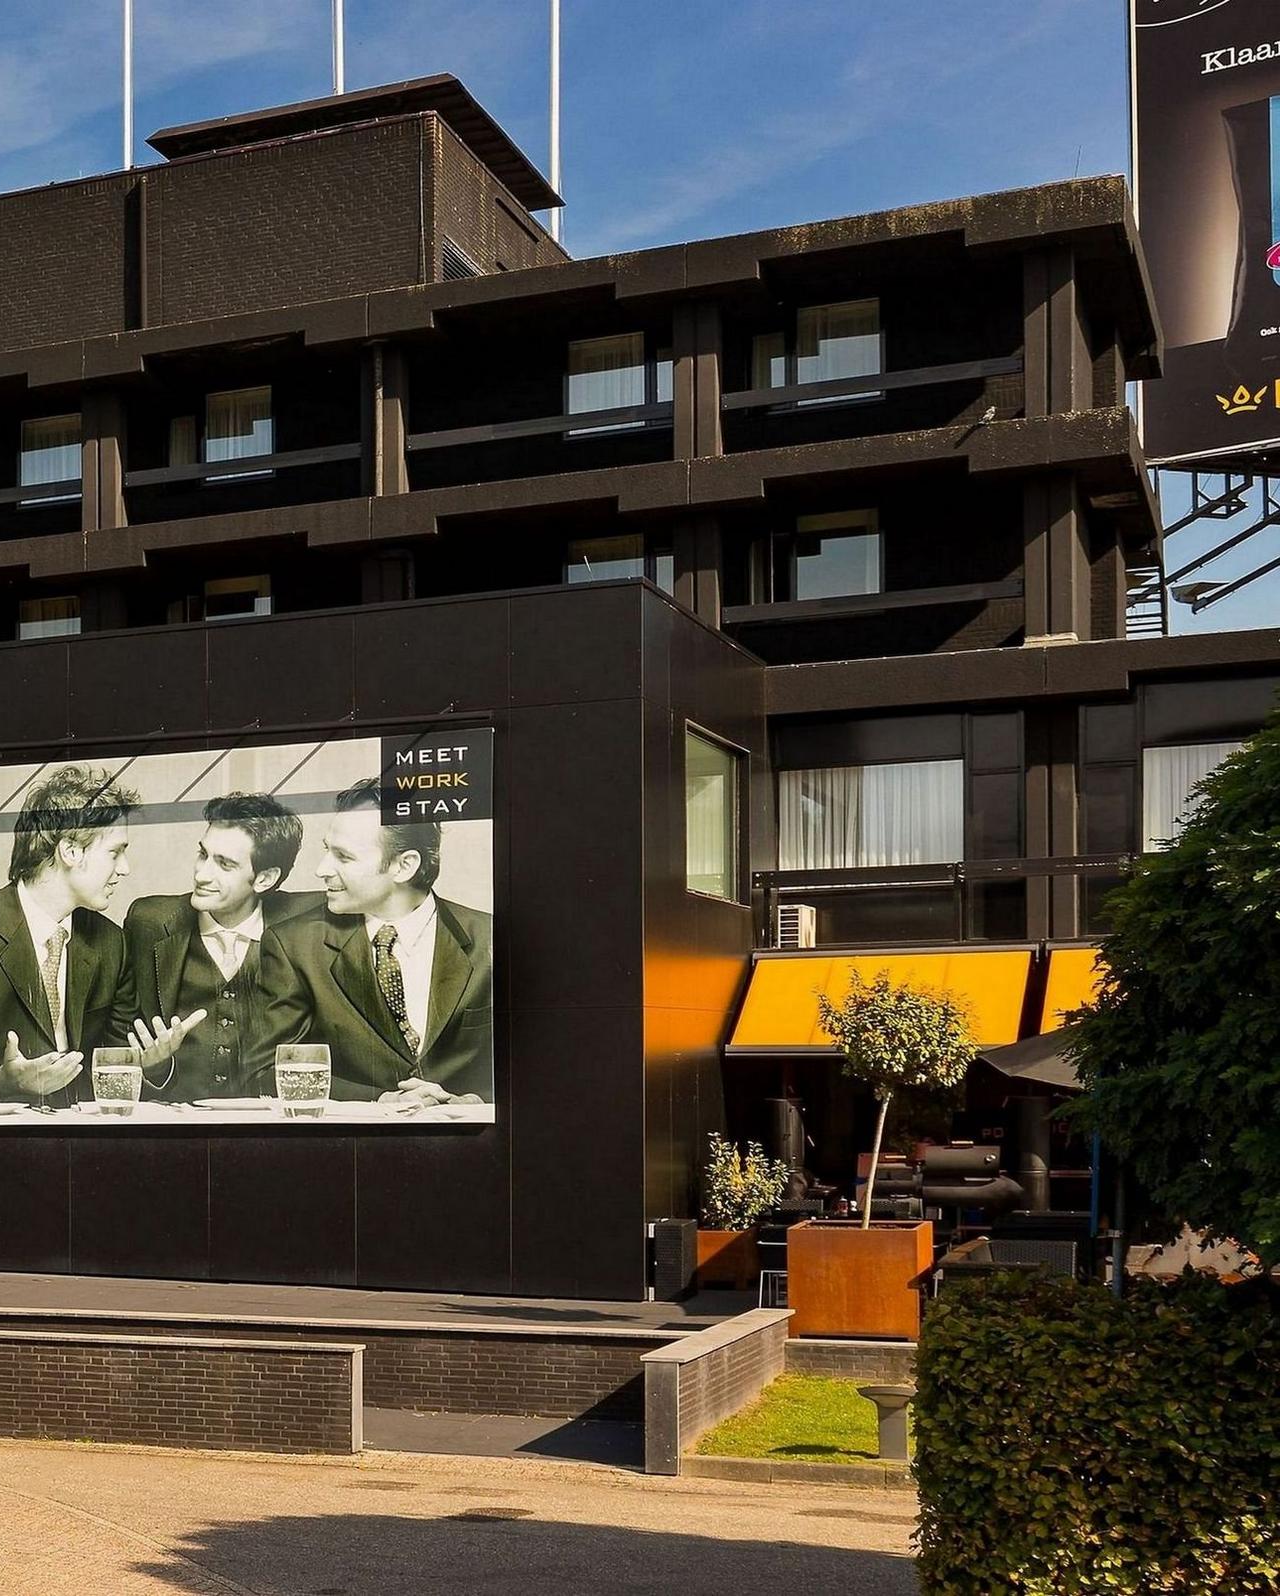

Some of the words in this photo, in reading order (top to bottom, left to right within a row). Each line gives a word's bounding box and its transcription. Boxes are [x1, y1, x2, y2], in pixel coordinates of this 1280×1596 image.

[395, 746, 469, 766] MEET
[396, 772, 469, 790] WORK
[395, 797, 469, 816] STAY
